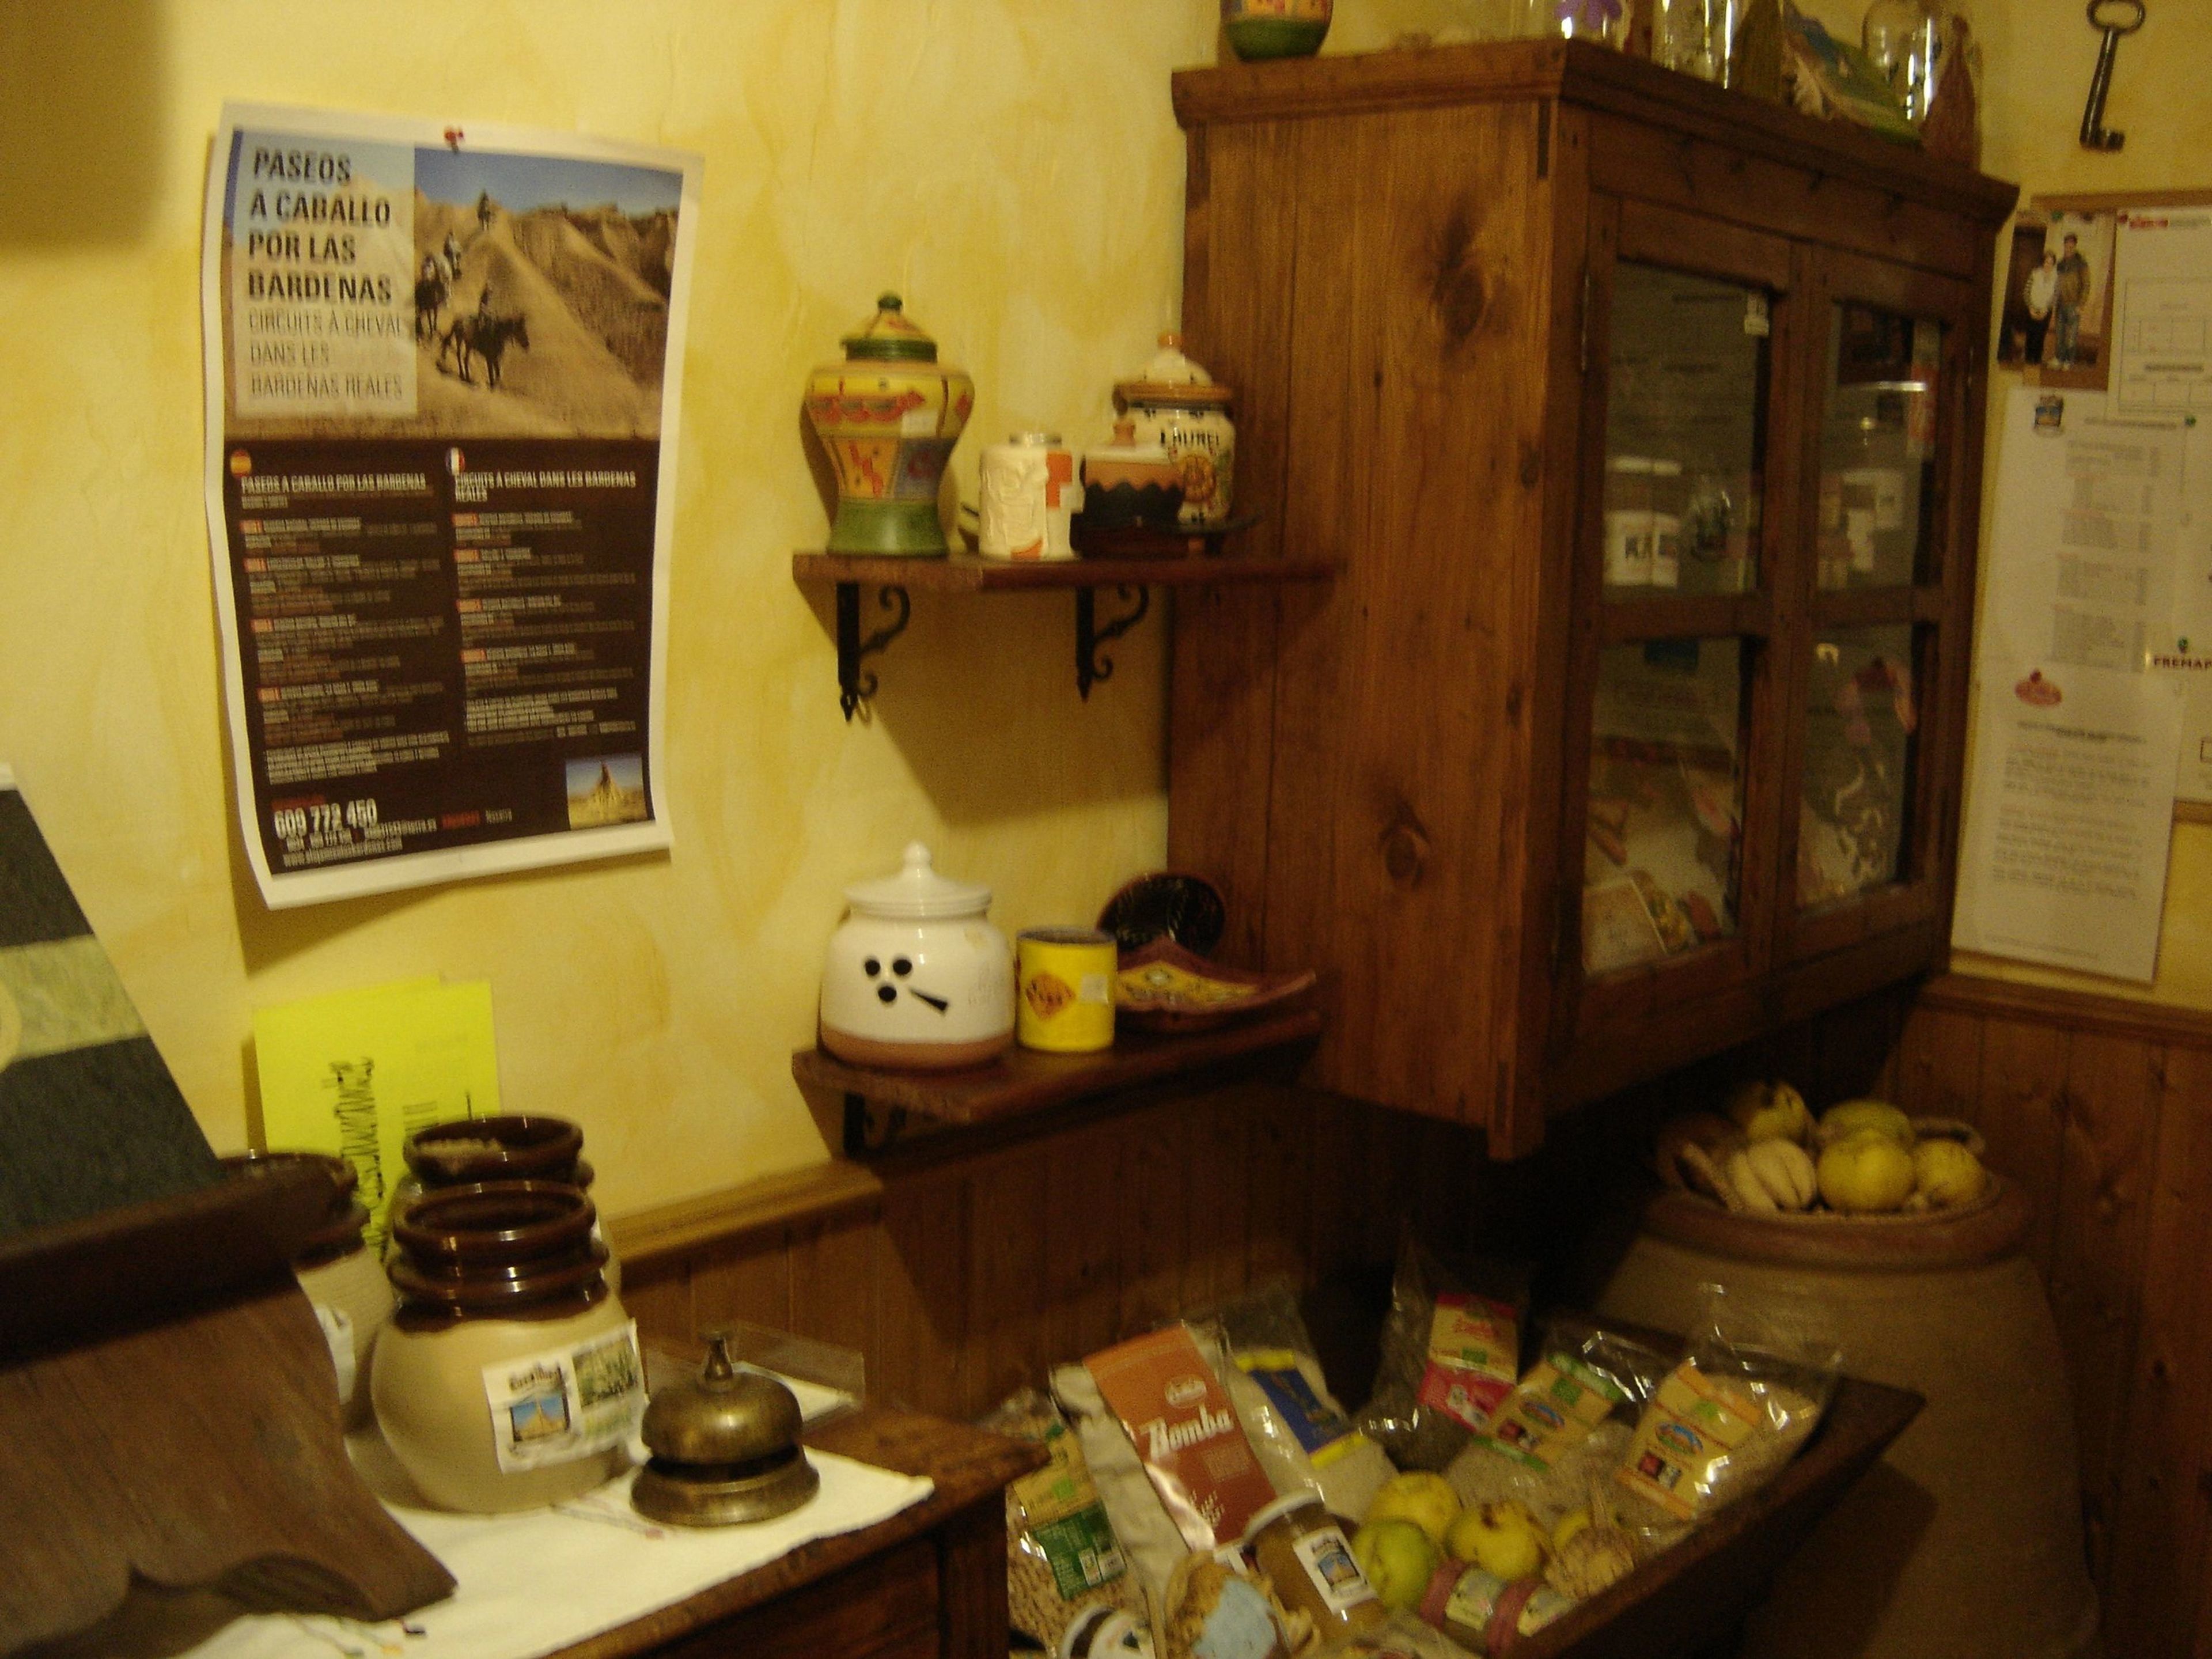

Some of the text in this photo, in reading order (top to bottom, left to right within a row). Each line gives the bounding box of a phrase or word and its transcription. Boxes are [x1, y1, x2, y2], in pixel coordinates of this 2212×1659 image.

[254, 147, 351, 185] PASEOS
[250, 189, 391, 228] A CABALLO
[248, 230, 356, 264] POR LAS
[248, 271, 392, 305] BARDENAS
[249, 307, 323, 335] CIRCUITS
